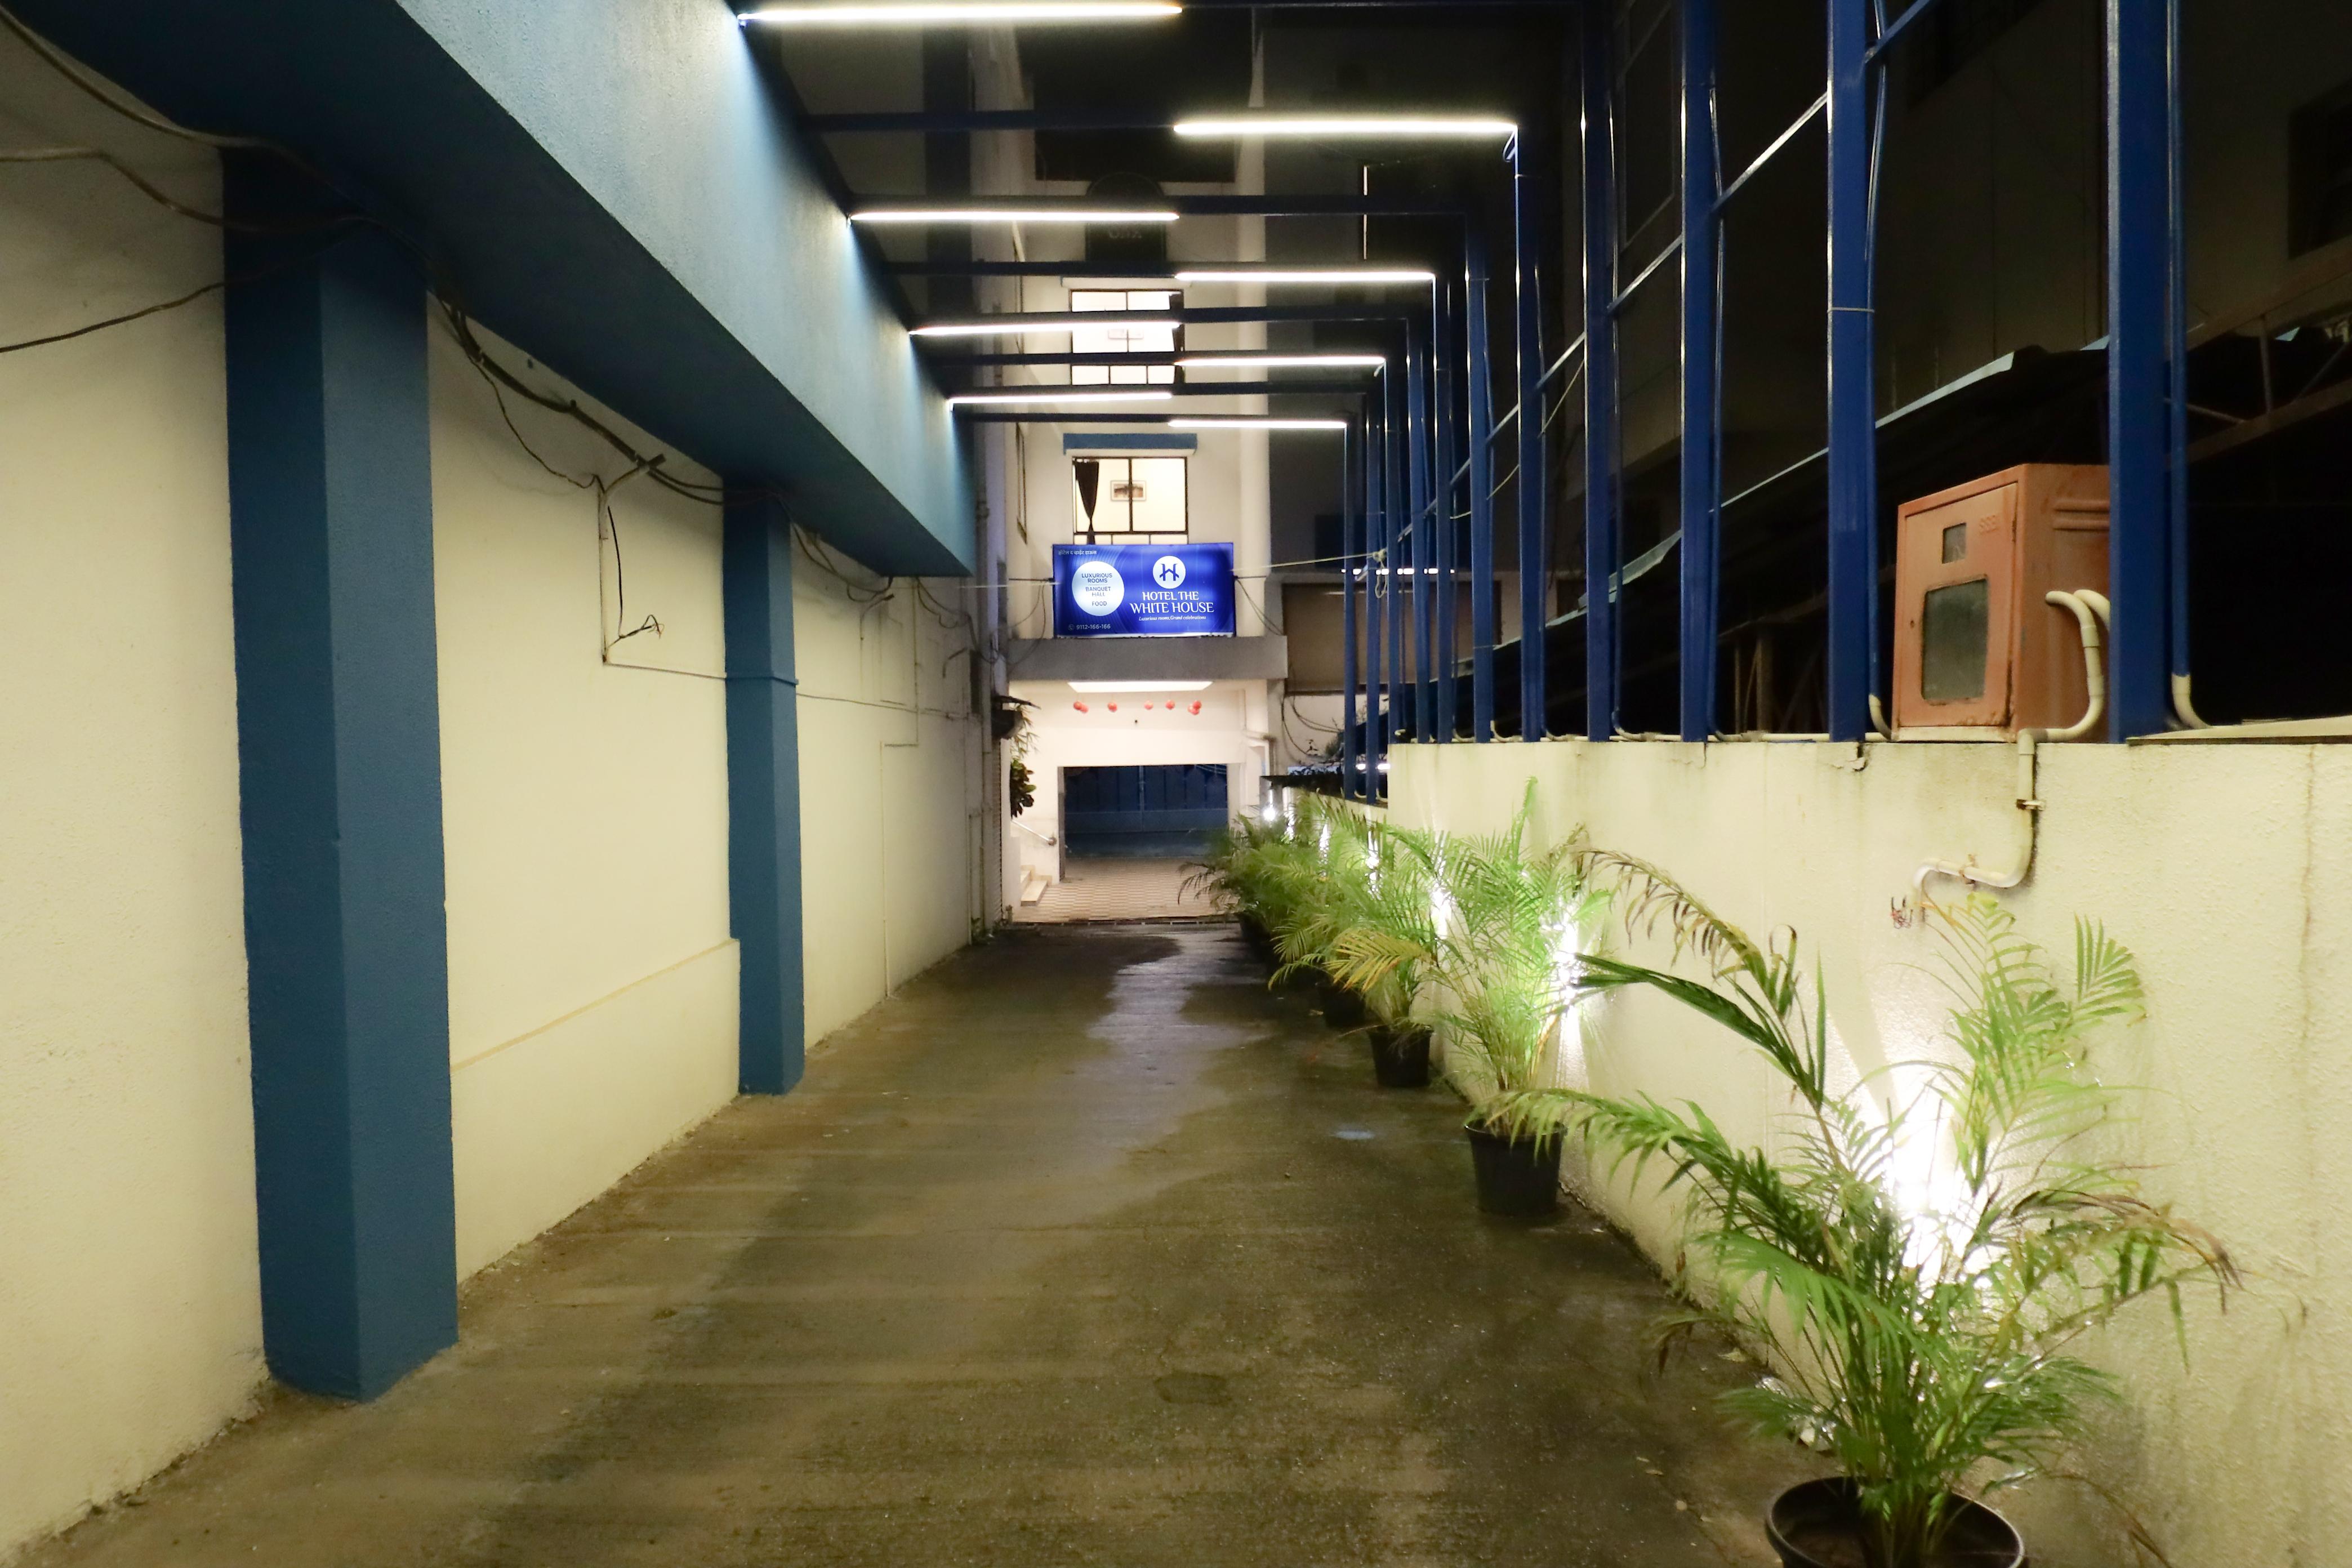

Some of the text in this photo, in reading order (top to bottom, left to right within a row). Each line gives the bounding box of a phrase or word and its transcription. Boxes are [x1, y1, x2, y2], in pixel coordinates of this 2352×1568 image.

[1142, 591, 1199, 600] HOTEL THE
[1129, 602, 1214, 613] WHITE HOUSE
